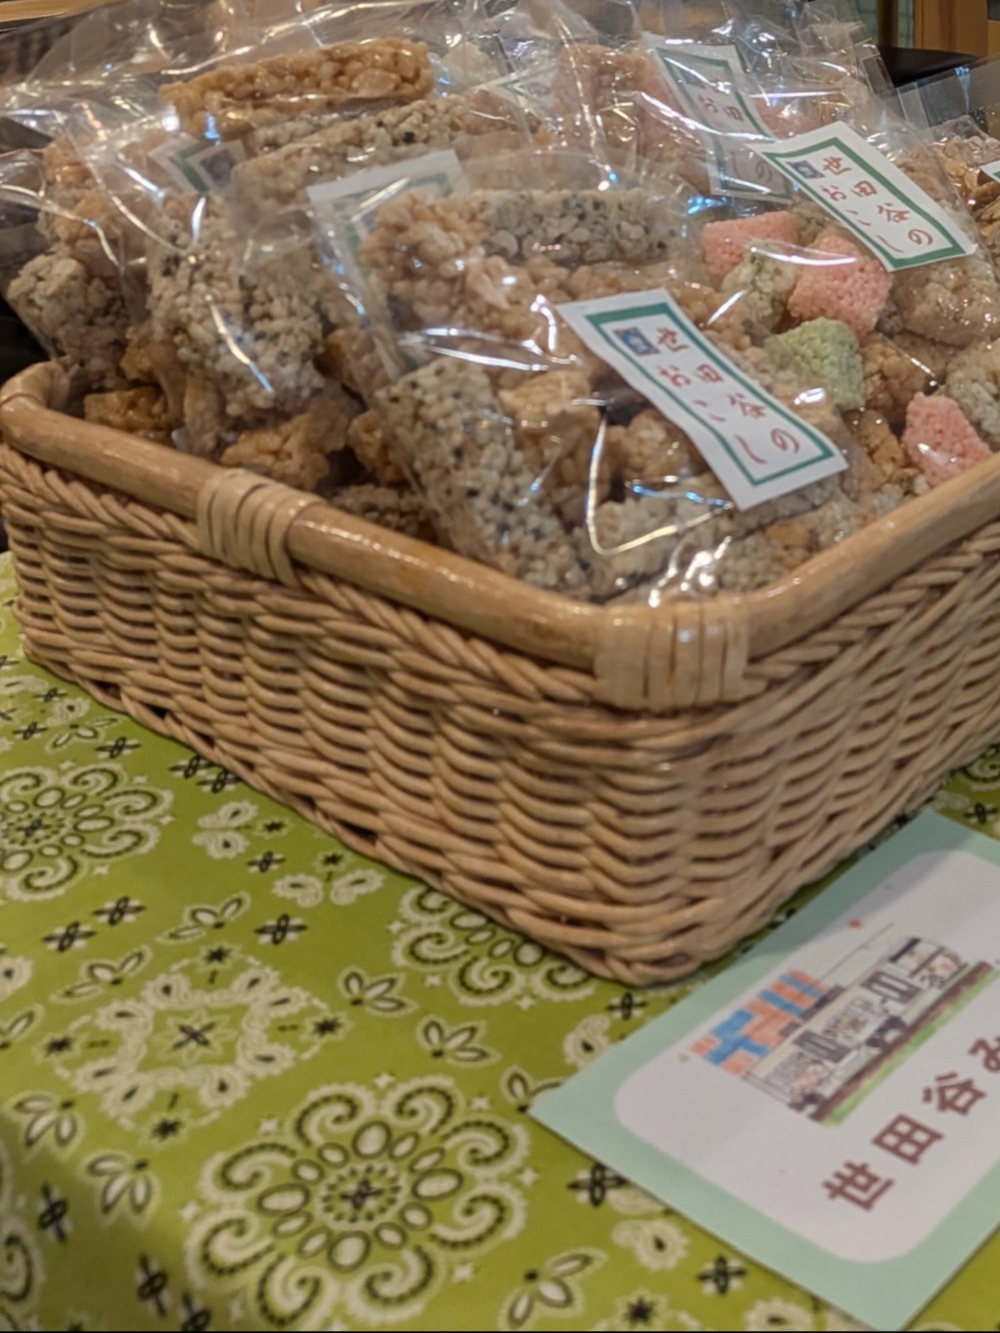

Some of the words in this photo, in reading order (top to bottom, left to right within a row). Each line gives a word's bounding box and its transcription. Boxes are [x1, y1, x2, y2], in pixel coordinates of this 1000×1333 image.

[820, 184, 904, 254] おこし
[822, 155, 934, 247] 世田谷の
[656, 326, 800, 454] 世田谷の
[658, 364, 768, 465] おこし
